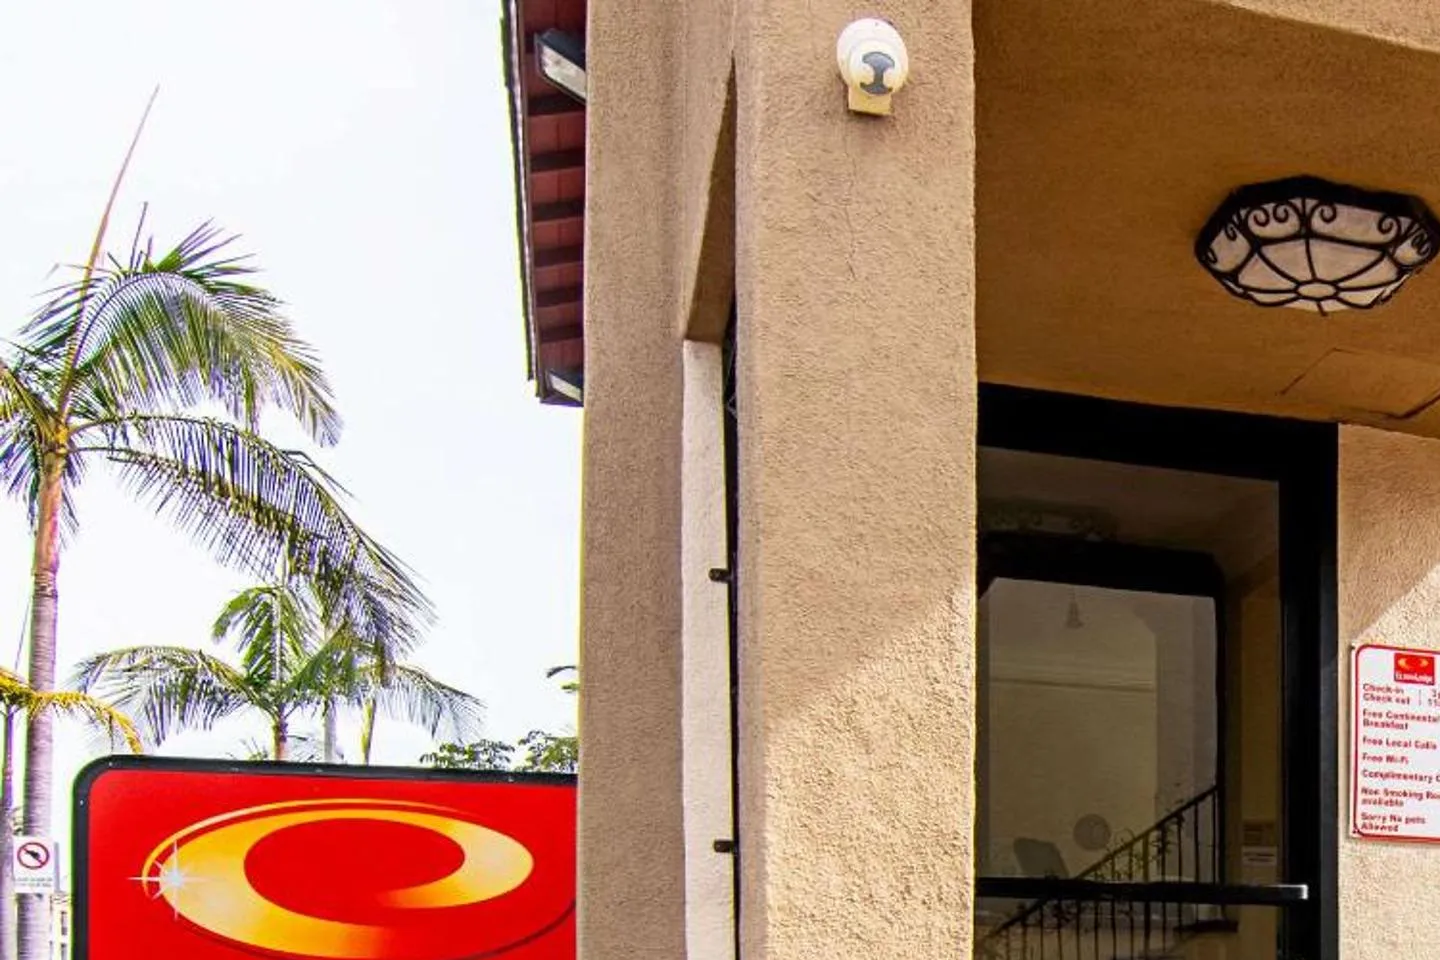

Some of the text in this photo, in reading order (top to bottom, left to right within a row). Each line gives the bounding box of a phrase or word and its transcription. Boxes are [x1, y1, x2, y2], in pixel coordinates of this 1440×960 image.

[1362, 708, 1440, 723] Free Continental
[1363, 718, 1408, 730] Breakfast
[1362, 735, 1383, 745] Free
[1386, 738, 1412, 748] Local
[1362, 752, 1383, 762] Free
